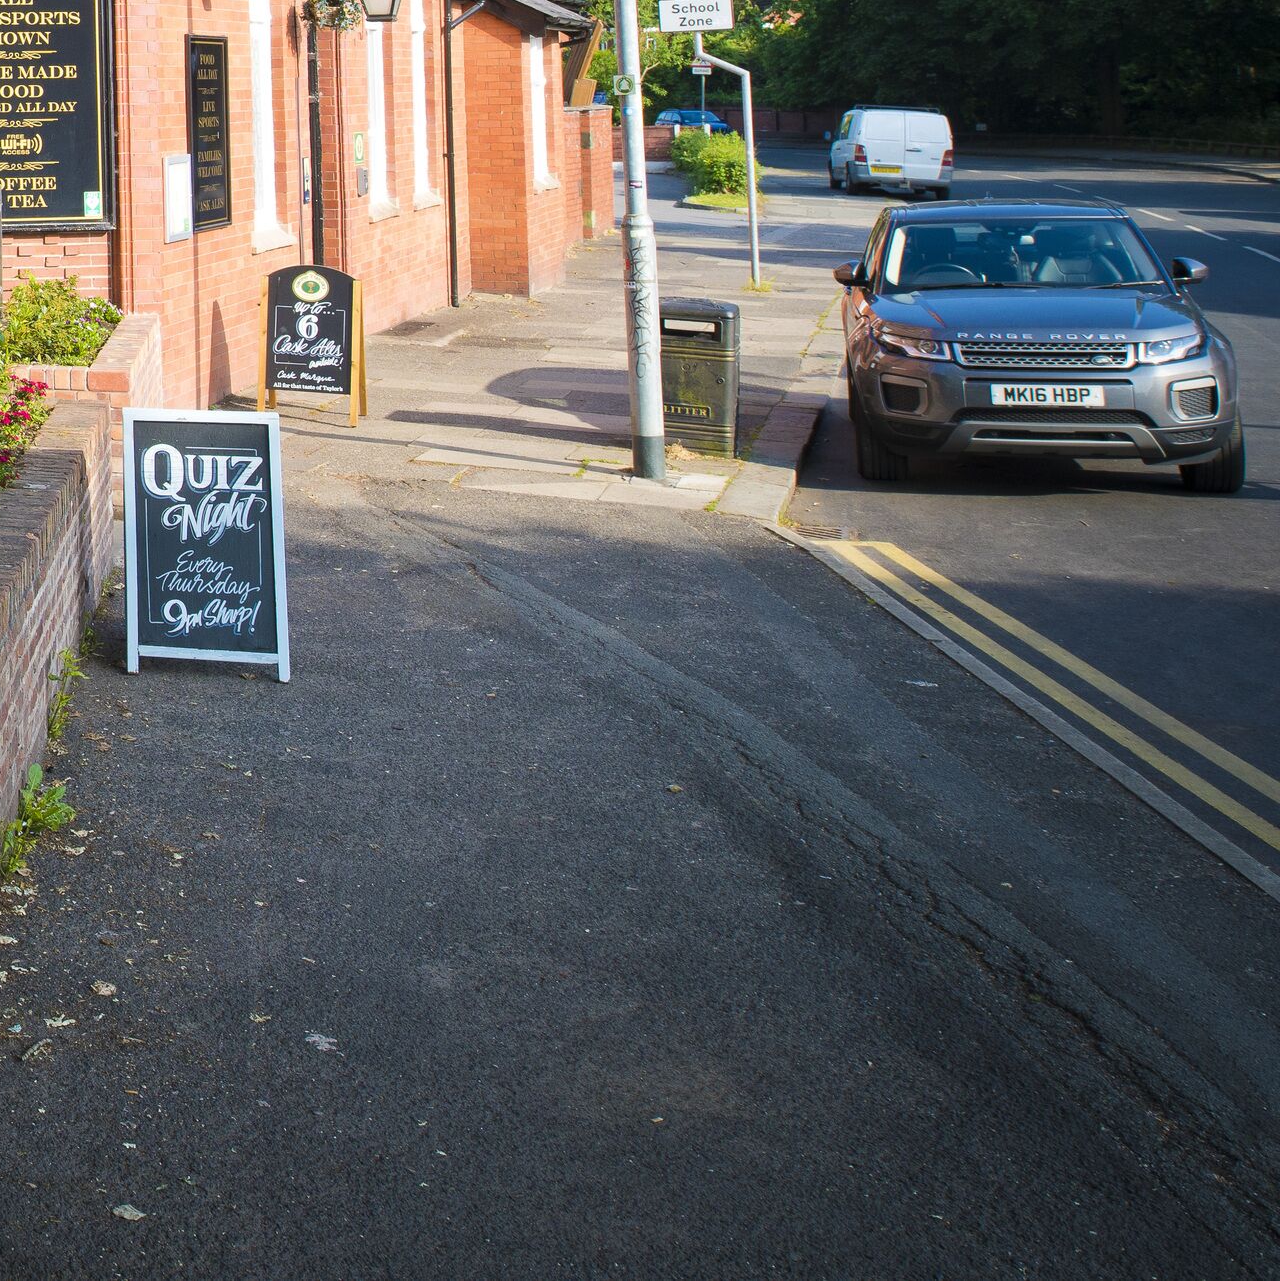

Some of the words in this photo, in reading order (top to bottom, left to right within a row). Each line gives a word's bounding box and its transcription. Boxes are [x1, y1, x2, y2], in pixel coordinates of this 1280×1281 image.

[671, 2, 720, 14] School
[0, 11, 81, 25] SPORTS
[679, 17, 713, 27] Zone
[200, 54, 215, 65] FOOD
[17, 65, 77, 79] MADE
[197, 69, 208, 80] ALL
[15, 102, 45, 113] ALL
[48, 101, 77, 112] DAY
[203, 101, 215, 112] LIVE
[198, 116, 219, 128] SPORTS
[0, 139, 31, 149] WI-FI
[198, 150, 222, 162] FAMILIES
[198, 166, 223, 178] WELCOME
[7, 194, 48, 208] TEA
[297, 314, 319, 340] 6
[957, 332, 1033, 340] RANGE
[273, 335, 309, 355] Cask
[310, 338, 344, 357] Ales
[277, 370, 297, 379] Cask
[1004, 387, 1046, 402] MK16
[1053, 388, 1090, 403] HBP
[664, 405, 707, 417] LITTER
[141, 443, 263, 502] QUIZ
[161, 491, 267, 546] Night
[176, 550, 233, 579] Every
[156, 571, 260, 603] Thursday
[204, 599, 262, 635] Sharp!
